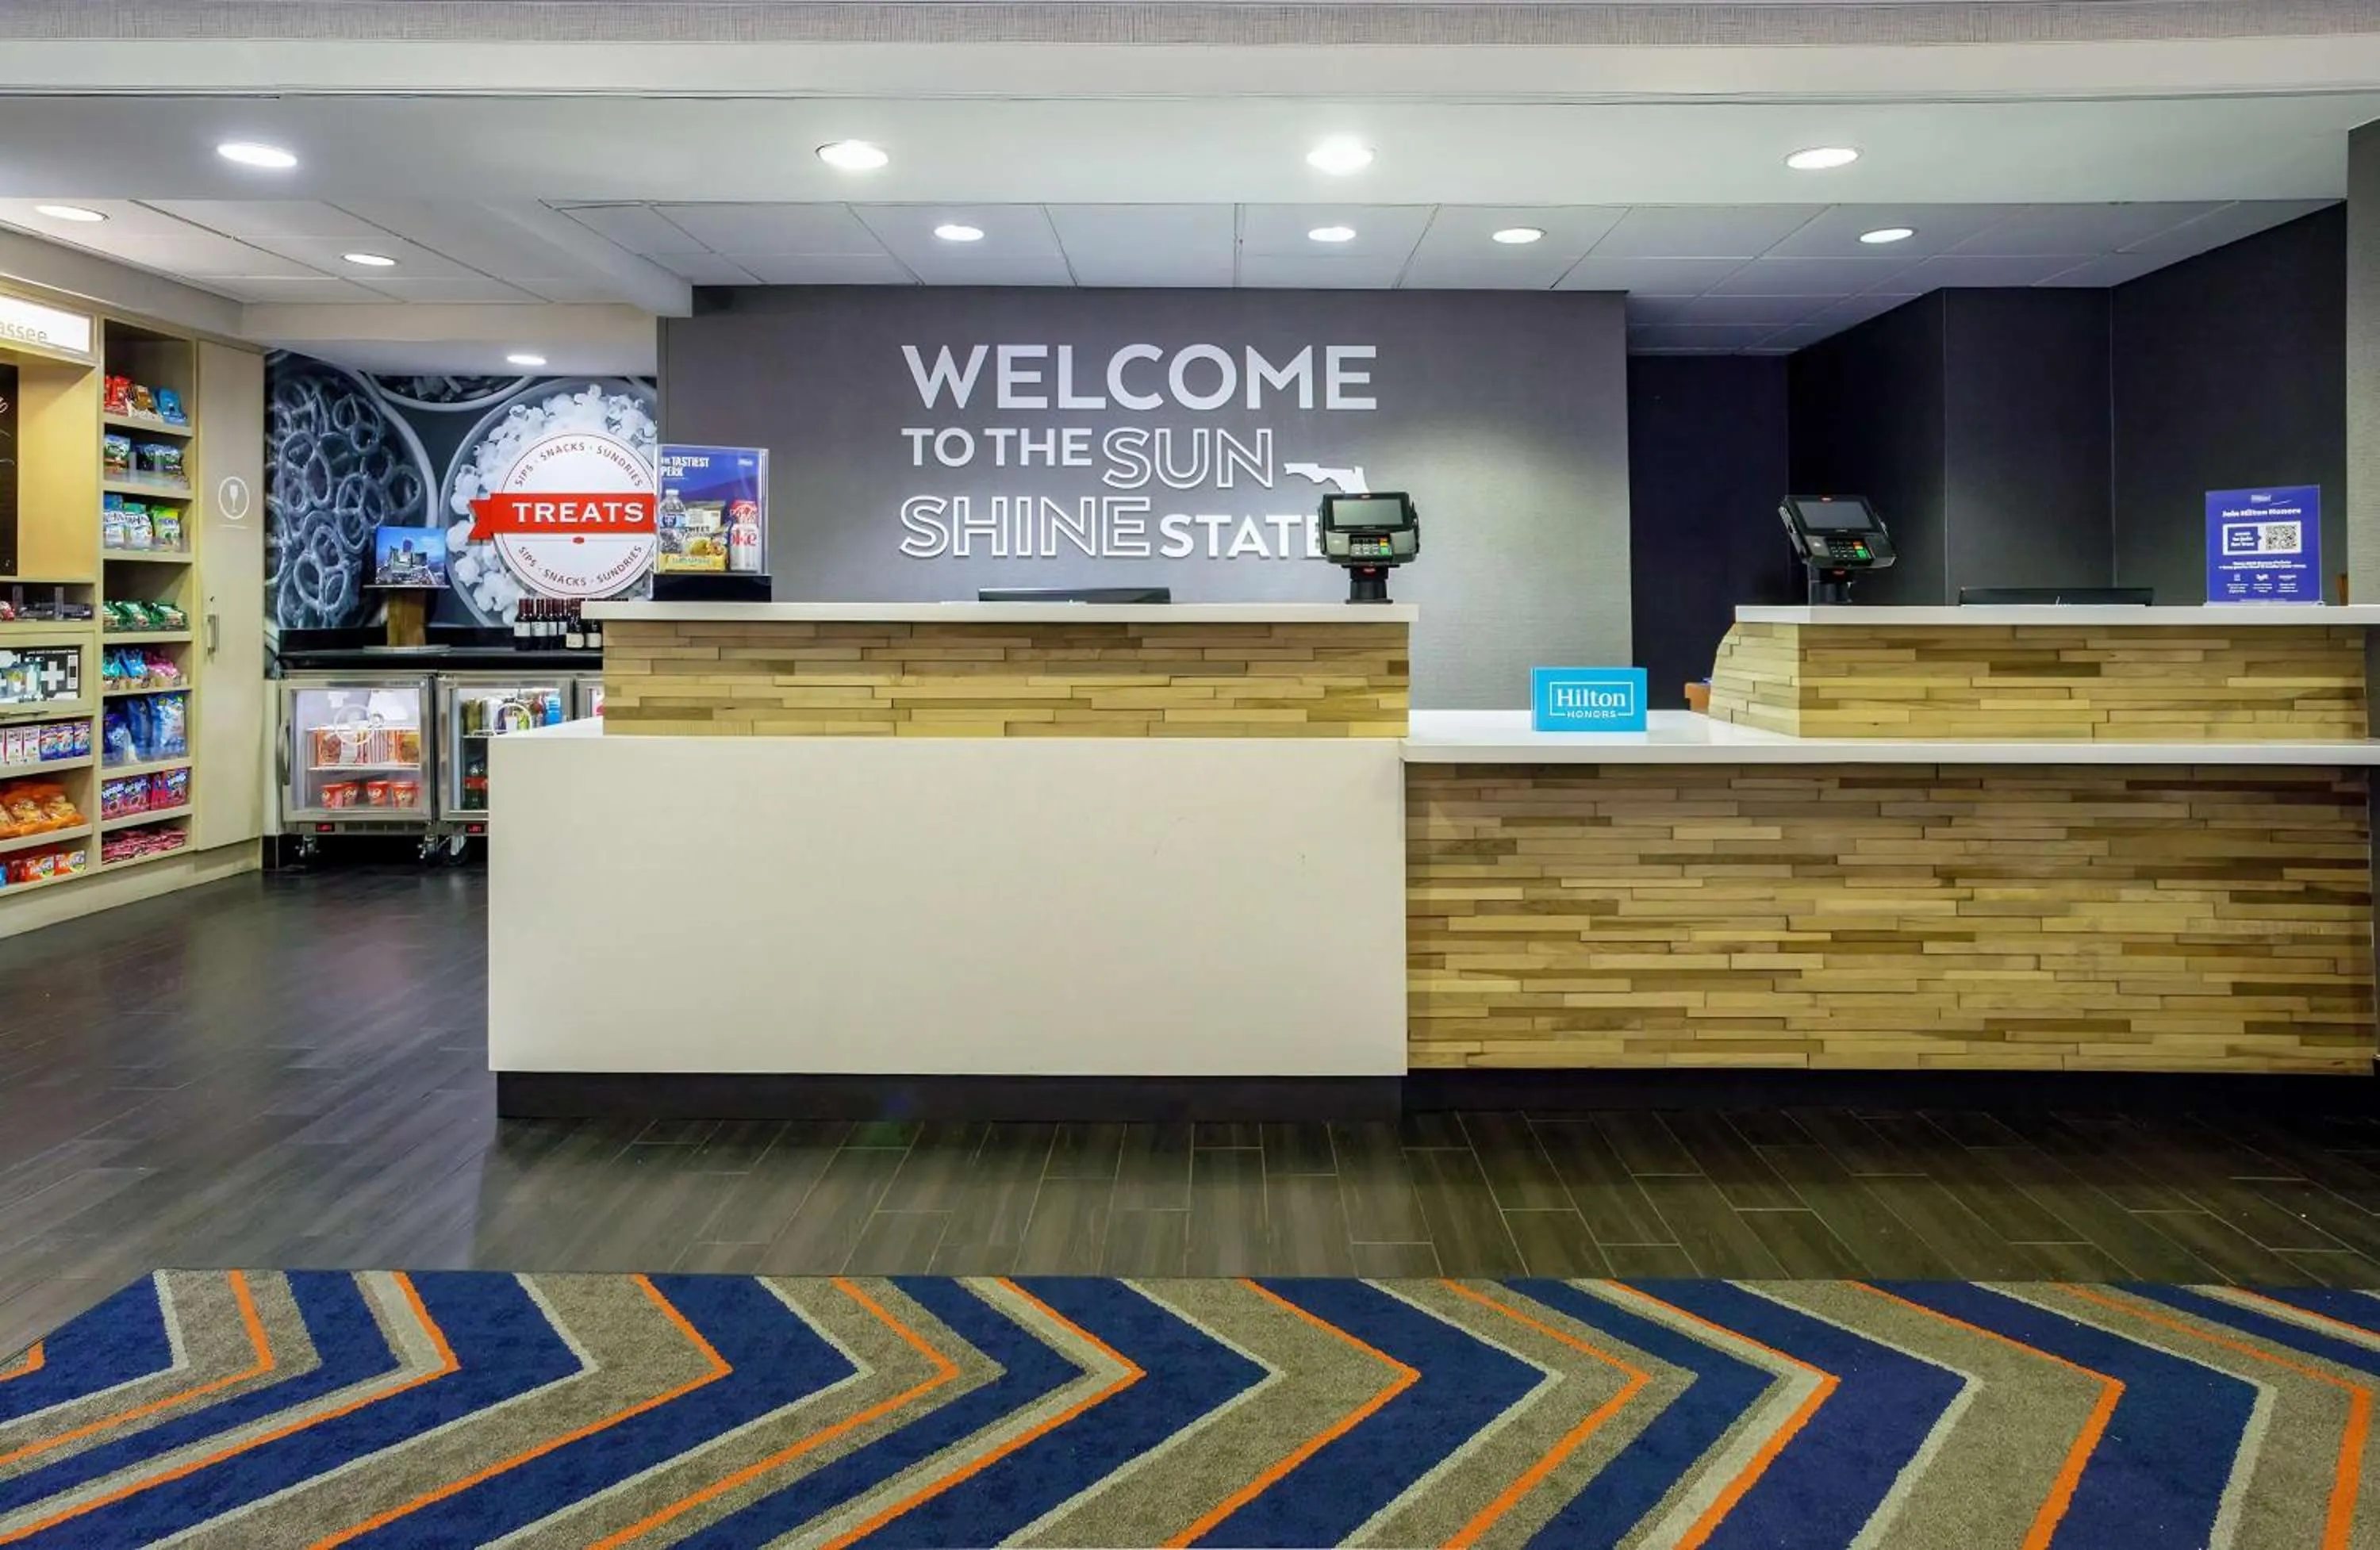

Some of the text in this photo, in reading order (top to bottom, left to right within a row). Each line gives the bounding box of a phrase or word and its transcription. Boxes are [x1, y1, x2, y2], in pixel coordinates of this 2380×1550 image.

[901, 343, 1377, 410] WELCOME
[515, 442, 643, 487] SIPS SNACKS SUNDRIES
[901, 428, 1273, 489] TO THE SUN
[512, 502, 645, 524] TREATS
[900, 495, 1150, 558] SHINE
[518, 545, 642, 587] SIPS SNACKS SUNDRIES
[1557, 688, 1626, 708] Hilton
[1567, 710, 1617, 719] HONORS
